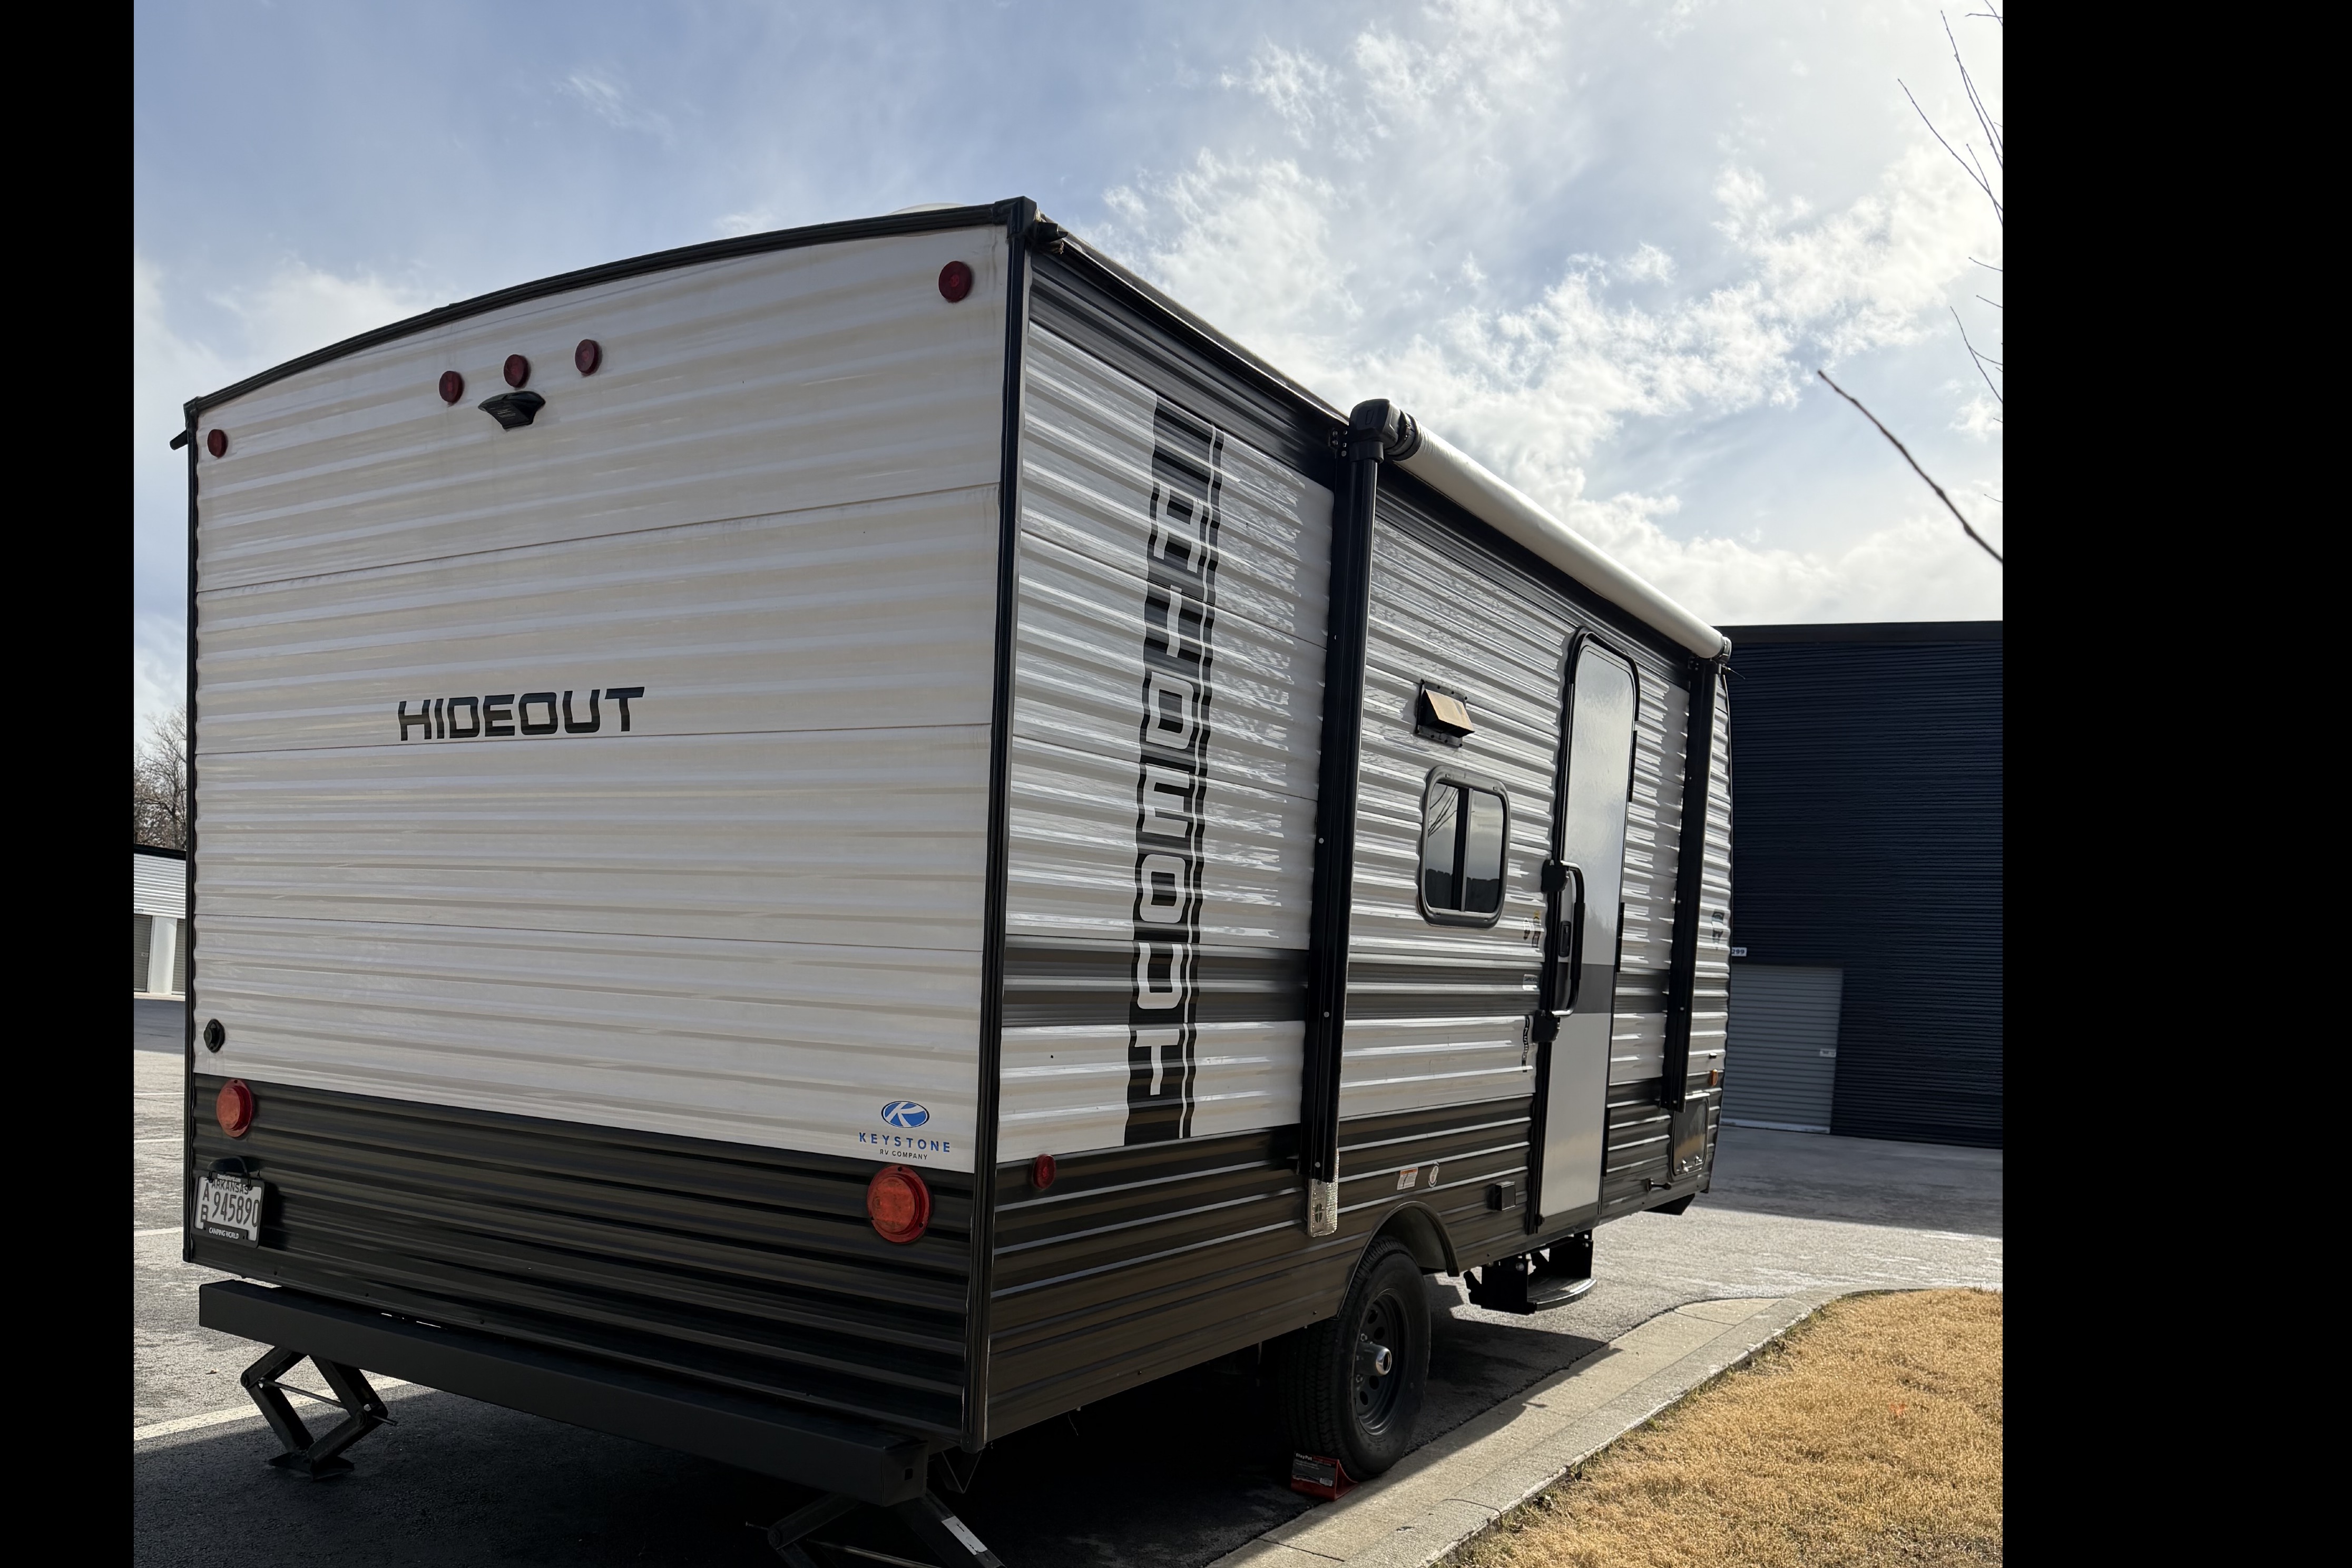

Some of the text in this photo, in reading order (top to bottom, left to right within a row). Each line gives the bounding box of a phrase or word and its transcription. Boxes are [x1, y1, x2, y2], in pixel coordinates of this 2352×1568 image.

[398, 687, 645, 741] HIDEOUT
[1134, 484, 1204, 1096] HIDEOUT
[859, 1132, 950, 1152] KEYSTONE
[892, 1151, 927, 1160] COMPANY
[211, 1180, 249, 1195] ARKANSAS
[212, 1191, 260, 1228] 945890
[209, 1227, 239, 1239] CAMPING WORLD
